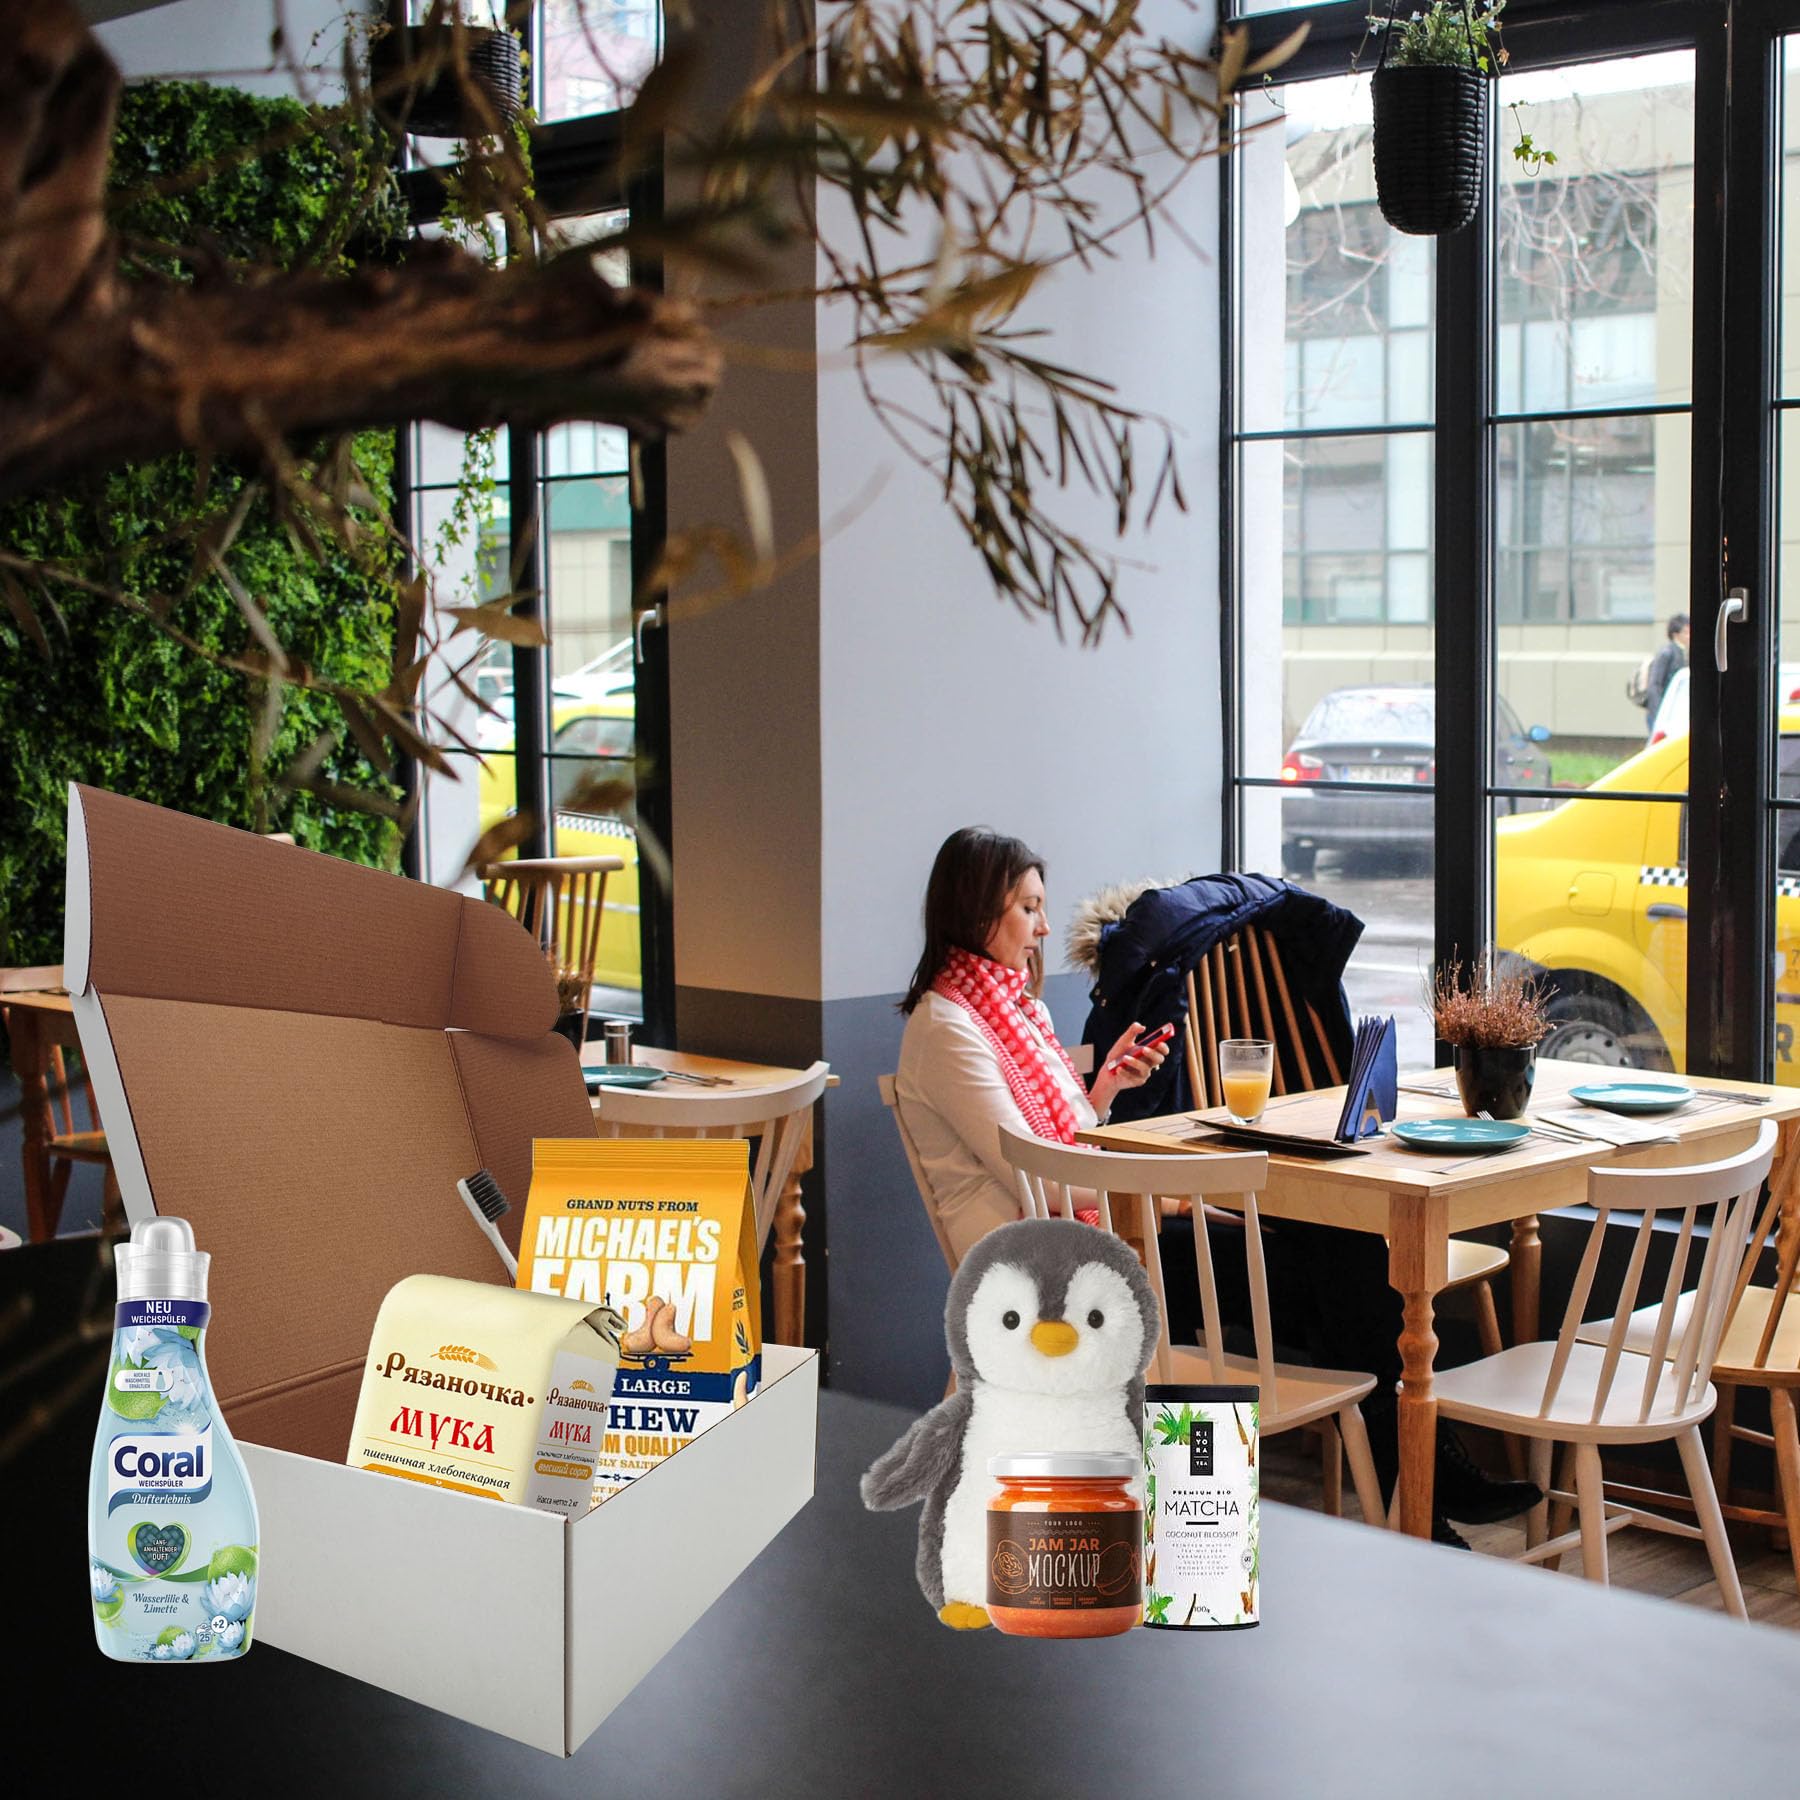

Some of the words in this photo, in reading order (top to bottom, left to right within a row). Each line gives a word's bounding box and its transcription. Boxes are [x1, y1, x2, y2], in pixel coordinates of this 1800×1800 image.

[566, 1199, 614, 1211] GRAND
[617, 1200, 654, 1211] NUTS
[657, 1201, 699, 1212] FROM
[535, 1215, 721, 1263] MICHAEL'S
[146, 1301, 172, 1314] NEU
[131, 1314, 187, 1324] WEICHSPÜLER
[621, 1378, 690, 1395] LARGE
[114, 1445, 204, 1478] Coral
[363, 1448, 426, 1469] пшеничная
[427, 1462, 511, 1489] хлебопекарная
[138, 1479, 183, 1487] WEICHSPÜLER
[131, 1493, 192, 1505] Dufterlebnis
[1164, 1500, 1239, 1516] MATCHA
[1165, 1530, 1203, 1539] COCONUT
[1203, 1530, 1239, 1539] BLOSSOM
[1029, 1538, 1064, 1551] JAM
[1069, 1538, 1100, 1551] JAR
[152, 1553, 169, 1561] DUFT
[1028, 1553, 1101, 1588] MOCKUP
[133, 1593, 180, 1604] Wasserlilie
[181, 1593, 190, 1604] &
[143, 1604, 178, 1614] Limette
[213, 1619, 225, 1629] +2
[199, 1633, 210, 1643] 25
